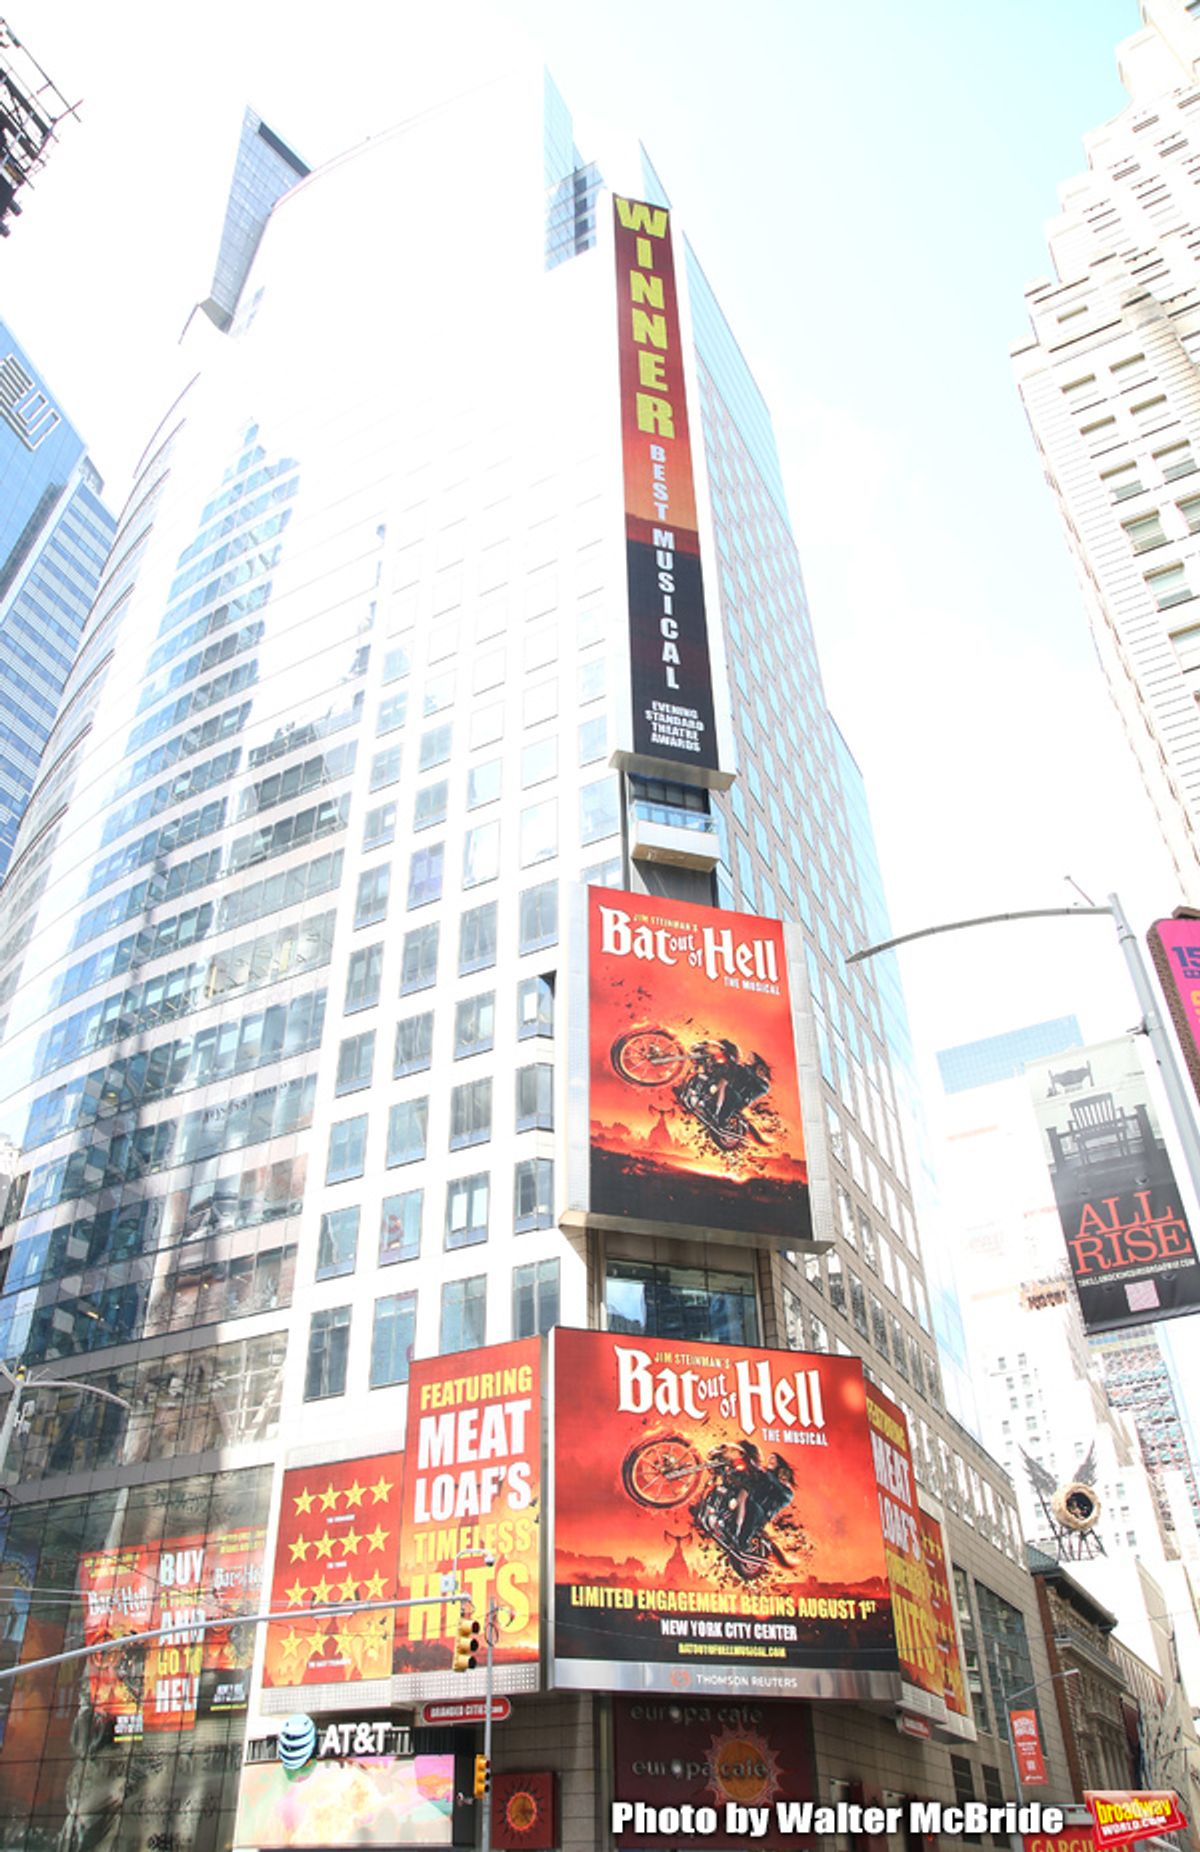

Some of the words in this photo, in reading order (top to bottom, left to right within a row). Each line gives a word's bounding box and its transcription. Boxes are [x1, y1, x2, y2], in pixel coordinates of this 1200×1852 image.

[614, 197, 675, 439] WINNER
[650, 444, 668, 520] BEST
[653, 528, 681, 690] MUSICAL
[645, 709, 705, 732] STANDARD
[651, 700, 699, 720] EVENING
[651, 721, 699, 741] THEATRE
[651, 732, 701, 753] AWARDS
[599, 905, 678, 966] Bat
[669, 933, 696, 952] out
[689, 948, 704, 967] of
[702, 927, 779, 983] Hell
[724, 976, 740, 990] THE
[742, 979, 781, 995] MUSICAL
[1075, 1190, 1174, 1238] ALL
[1069, 1220, 1193, 1274] RISE
[654, 1352, 673, 1364] JIM
[674, 1354, 731, 1369] STEINMAN'S
[420, 1364, 533, 1411] FEATURING
[614, 1344, 709, 1420] Bat
[697, 1373, 728, 1400] out
[720, 1392, 737, 1419] of
[735, 1360, 825, 1436] Hell
[417, 1398, 532, 1470] MEAT
[762, 1428, 781, 1442] THE
[783, 1430, 829, 1446] MUSICAL
[870, 1429, 912, 1507] MEAT
[414, 1462, 532, 1523] LOAF'S
[413, 1518, 532, 1563] TIMELESS
[160, 1549, 204, 1586] BUY
[408, 1561, 530, 1642] HITS
[571, 1585, 634, 1610] LIMITED
[637, 1588, 738, 1614] ENGAGEMENT
[740, 1595, 796, 1617] BEGINS
[798, 1598, 856, 1620] AUGUST
[858, 1600, 876, 1620] 1ST
[159, 1608, 205, 1647] AND
[660, 1619, 689, 1636] NEW
[690, 1620, 723, 1638] YORK
[724, 1621, 752, 1639] CITY
[754, 1623, 798, 1641] CENTER
[158, 1648, 180, 1675] GO
[696, 1673, 749, 1687] THOMSON
[751, 1675, 798, 1689] REUTERS
[320, 1722, 391, 1756] AT&T
